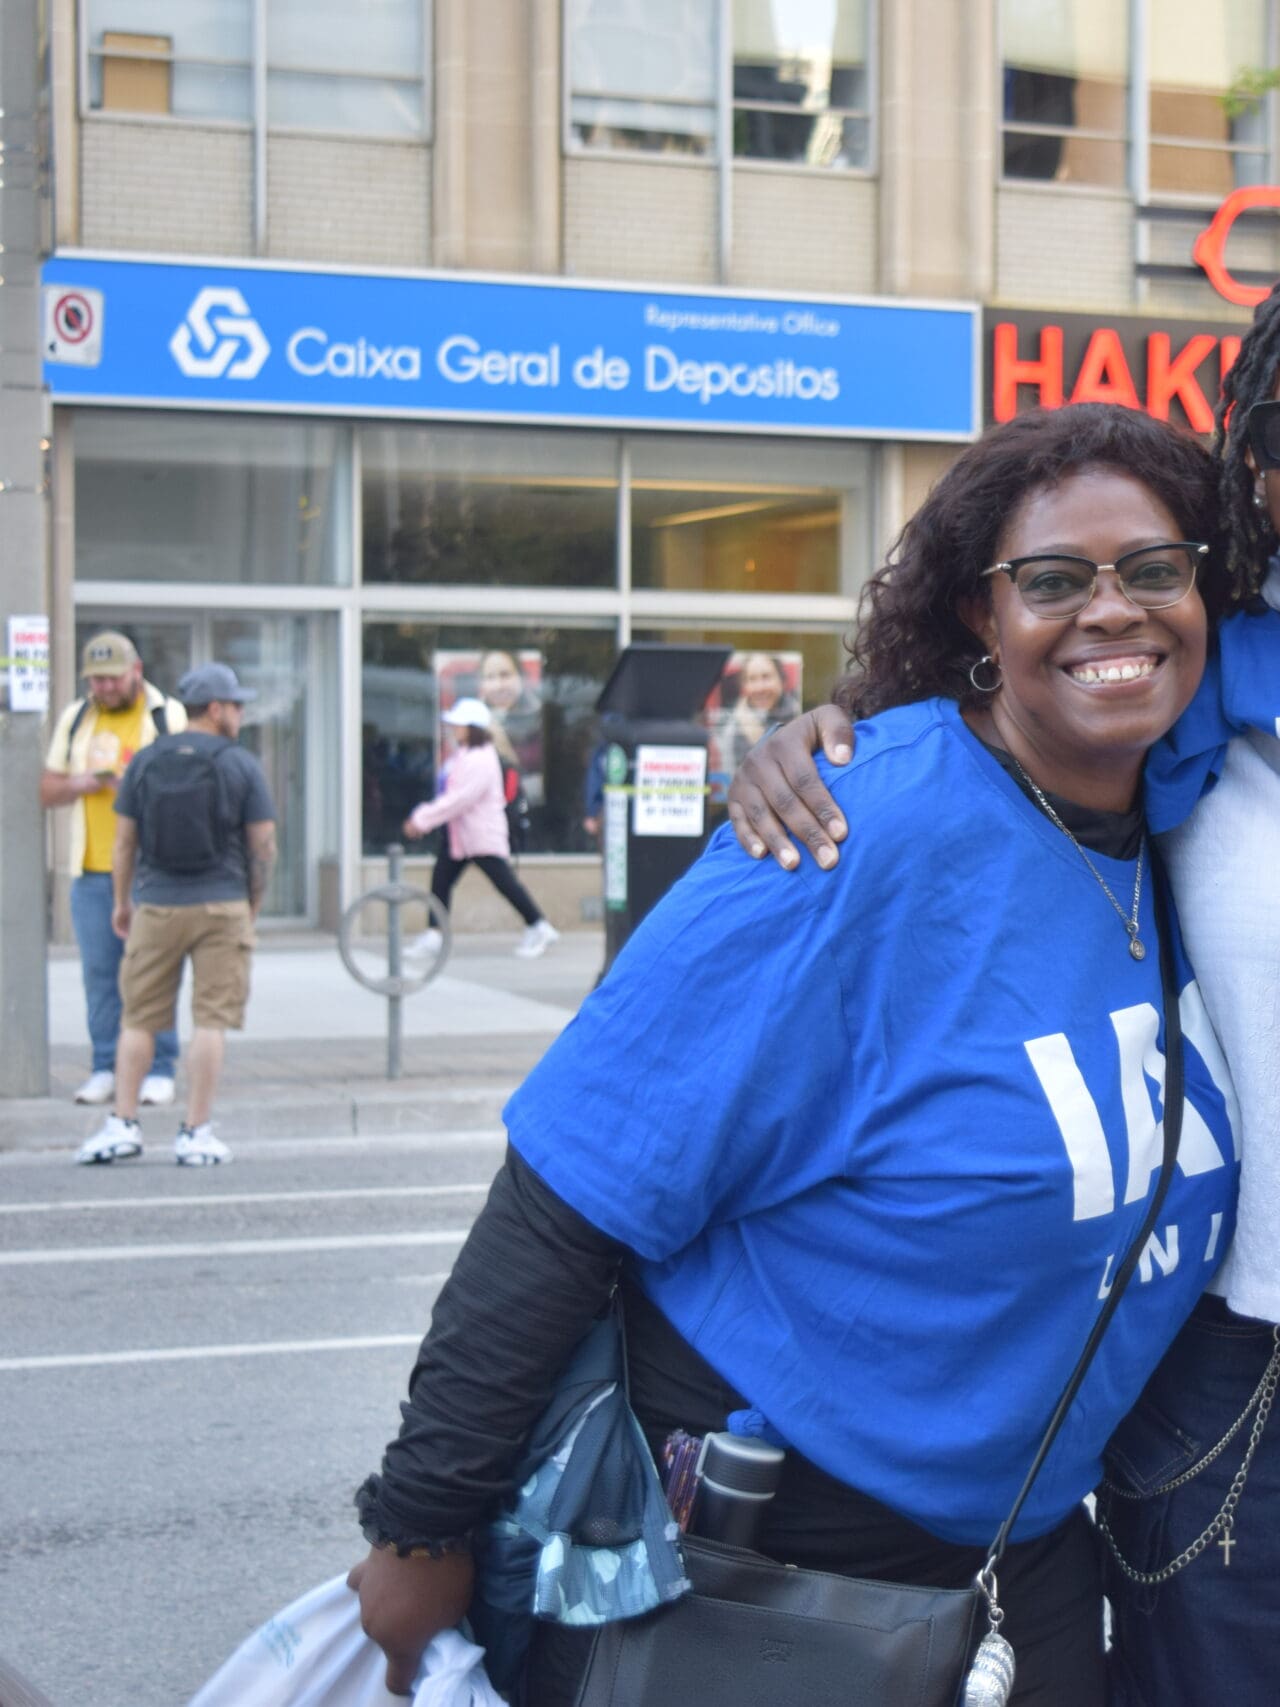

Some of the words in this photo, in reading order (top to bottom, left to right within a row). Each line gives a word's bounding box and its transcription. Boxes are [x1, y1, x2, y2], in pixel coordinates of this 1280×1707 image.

[782, 312, 841, 338] Office
[287, 327, 421, 381] Caixa
[437, 335, 560, 387] Geral
[572, 344, 631, 391] de
